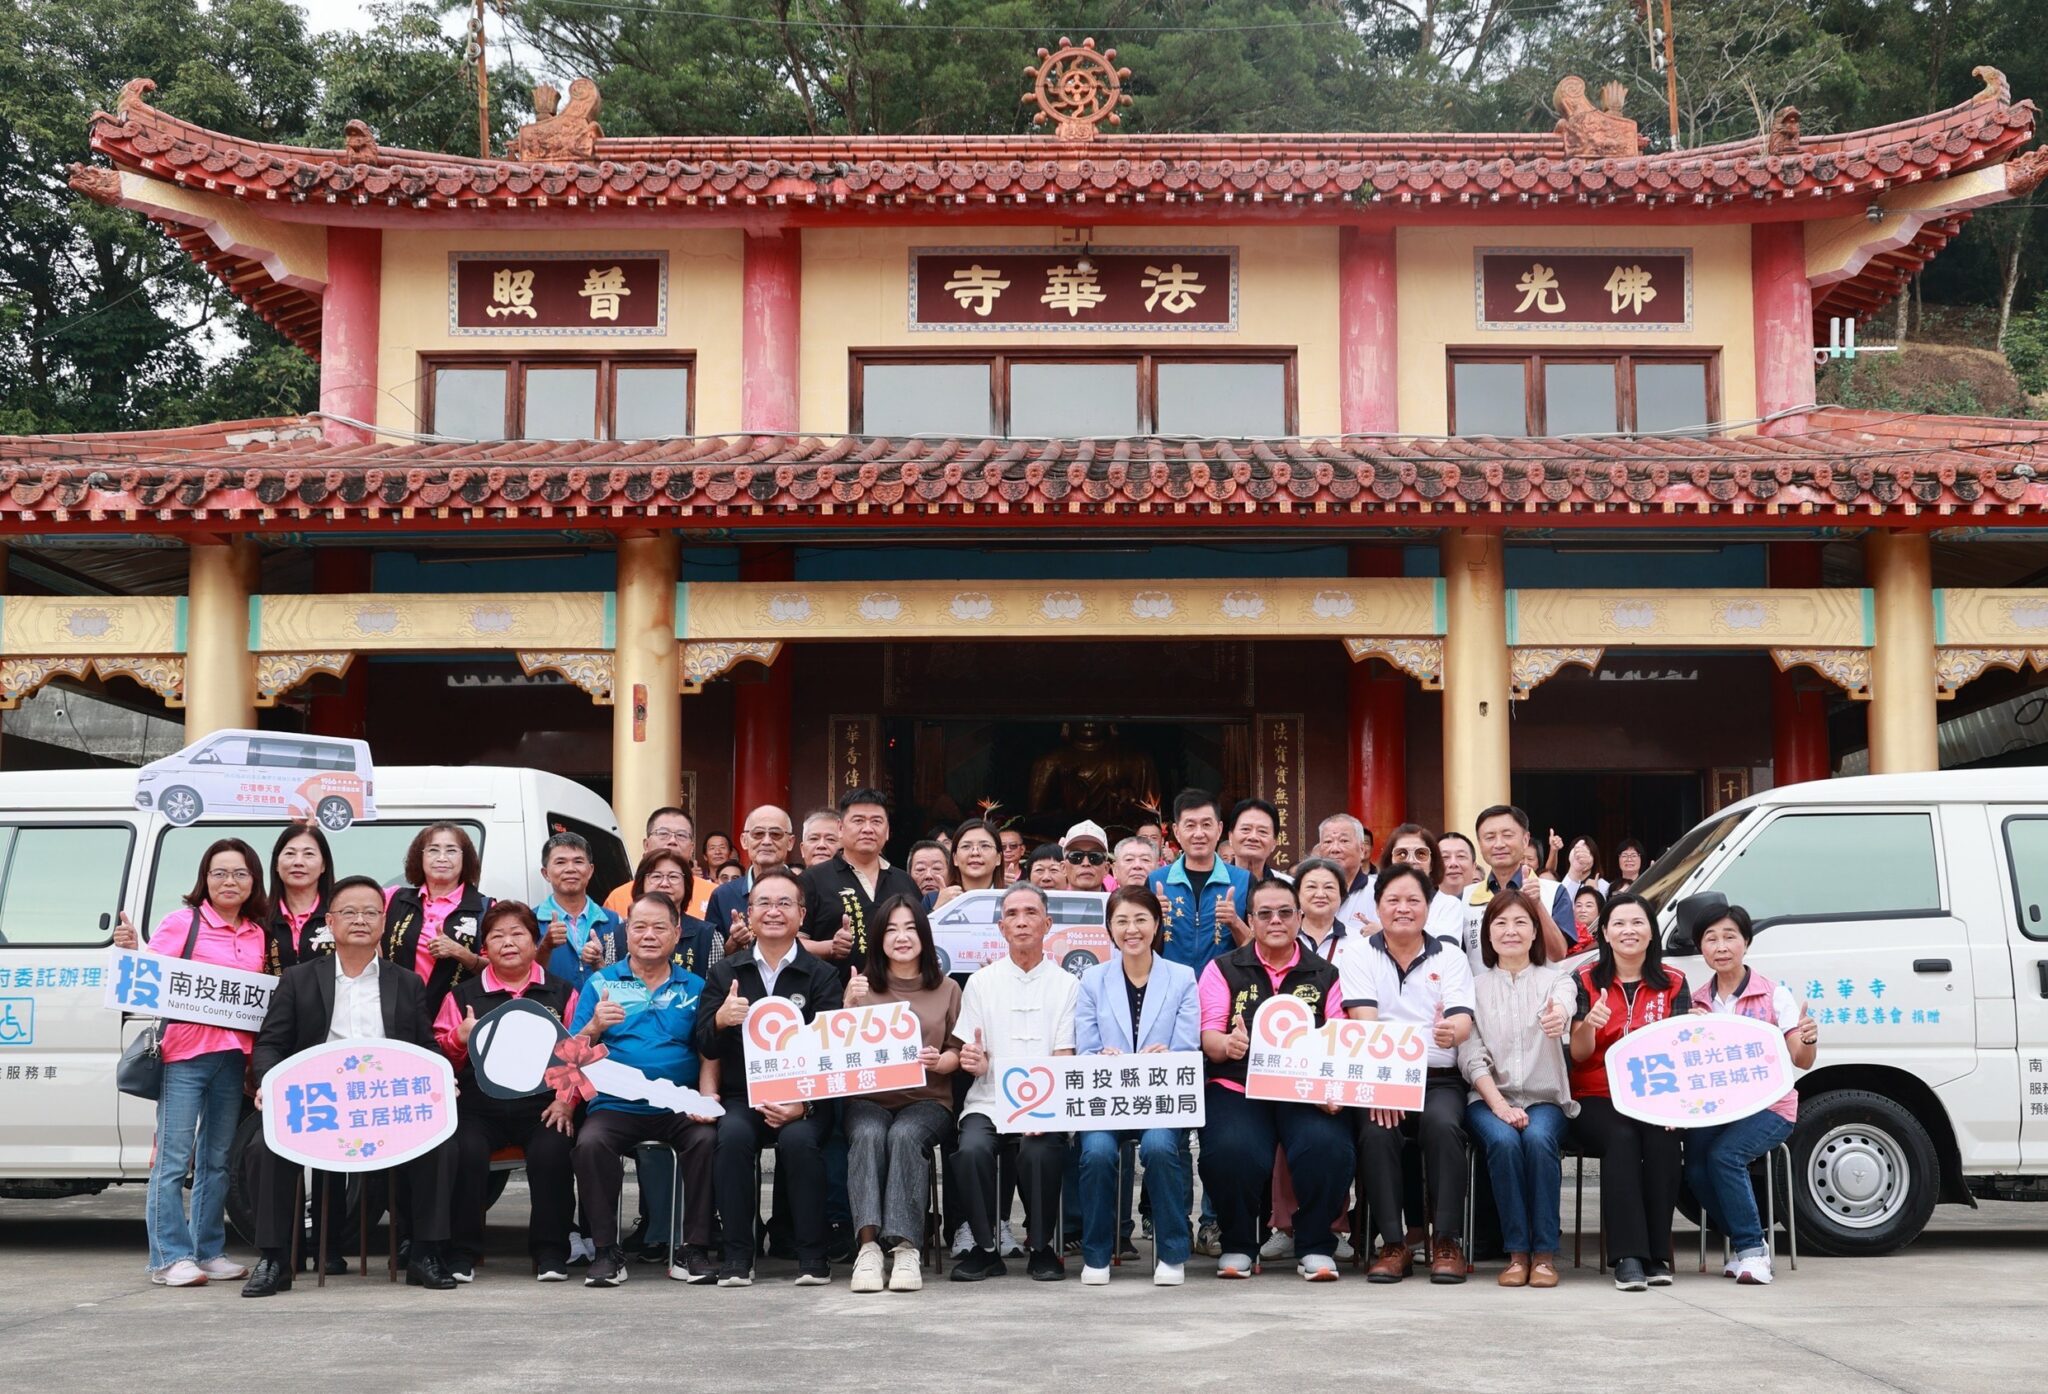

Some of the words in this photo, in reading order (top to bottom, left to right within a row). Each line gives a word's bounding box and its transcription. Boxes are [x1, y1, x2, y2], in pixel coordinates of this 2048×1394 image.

[486, 266, 631, 320] 普照
[944, 263, 1206, 317] 法華寺
[1514, 263, 1657, 315] 佛光
[1779, 978, 1886, 999] 法華寺
[168, 999, 200, 1012] Nantou
[203, 1005, 233, 1019] County
[236, 1011, 266, 1023] Govern
[812, 1005, 916, 1050] 1966
[1321, 1021, 1425, 1061] 1966
[818, 1045, 918, 1072] 長照專線
[1683, 1042, 1764, 1068] 觀光首都
[0, 1065, 57, 1080] 服務車
[797, 1070, 877, 1096] 守護您
[1065, 1066, 1196, 1089] 南投縣政府
[1319, 1062, 1421, 1084] 長照專線
[1688, 1065, 1769, 1091] 宜居城市
[346, 1076, 432, 1101] 觀光首都
[1295, 1080, 1375, 1103] 守護您
[348, 1103, 433, 1129] 宜居城市
[1066, 1094, 1197, 1117] 社會及勞動局
